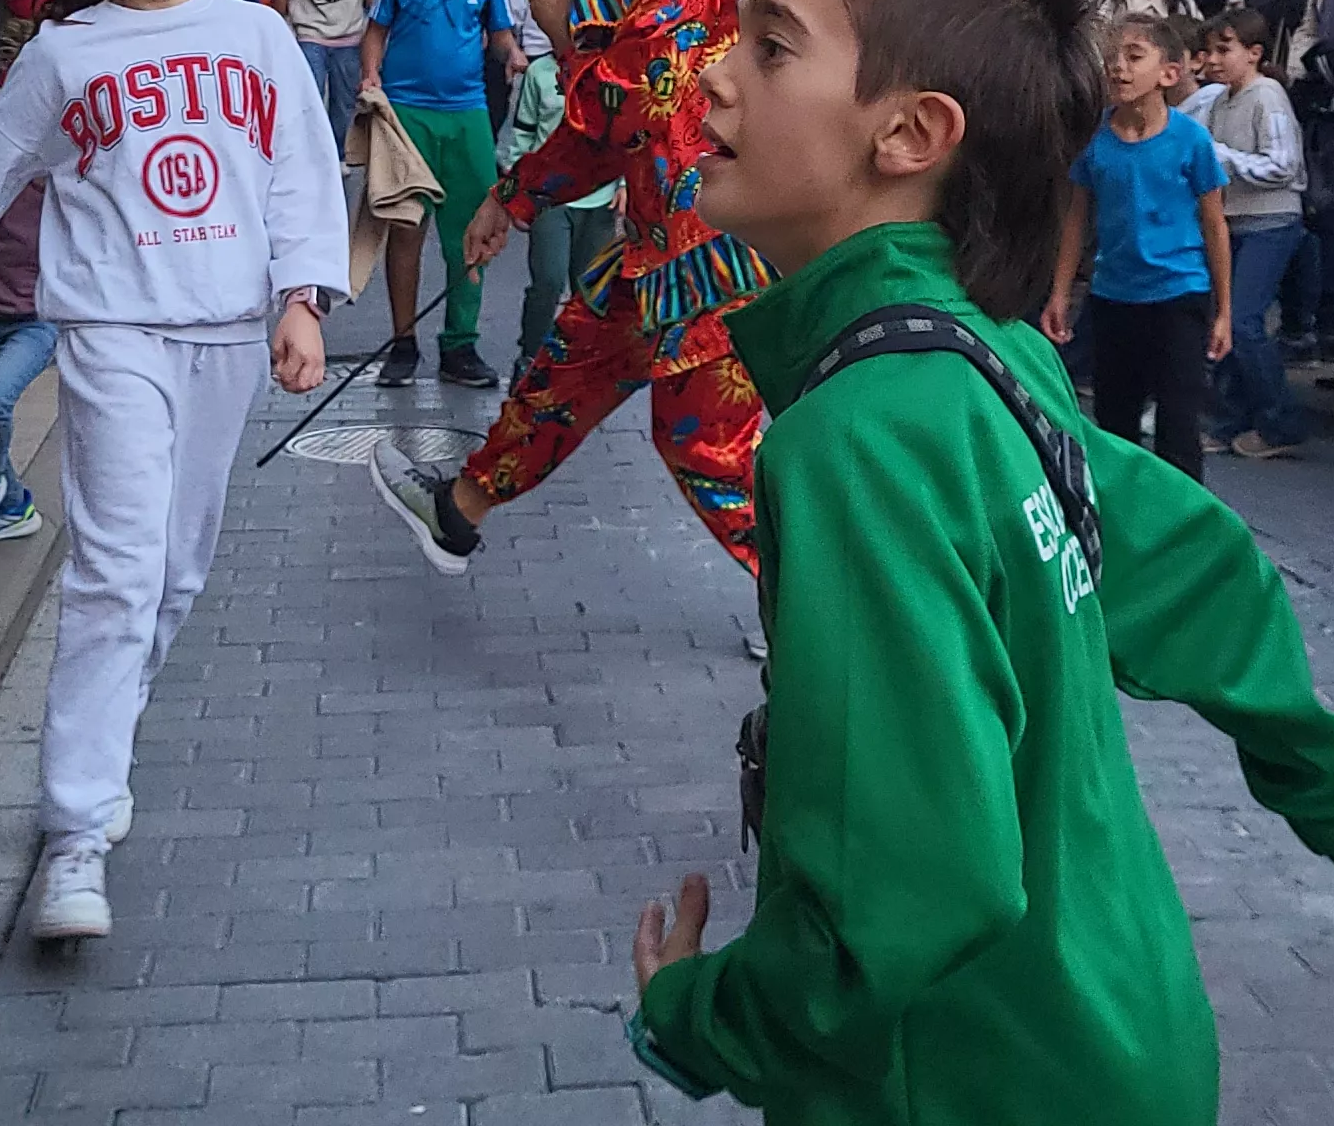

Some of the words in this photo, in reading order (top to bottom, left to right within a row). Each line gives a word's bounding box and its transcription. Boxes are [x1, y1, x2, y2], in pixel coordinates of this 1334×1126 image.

[59, 52, 279, 181] BOSTON
[157, 152, 208, 199] USA
[136, 230, 162, 247] ALL
